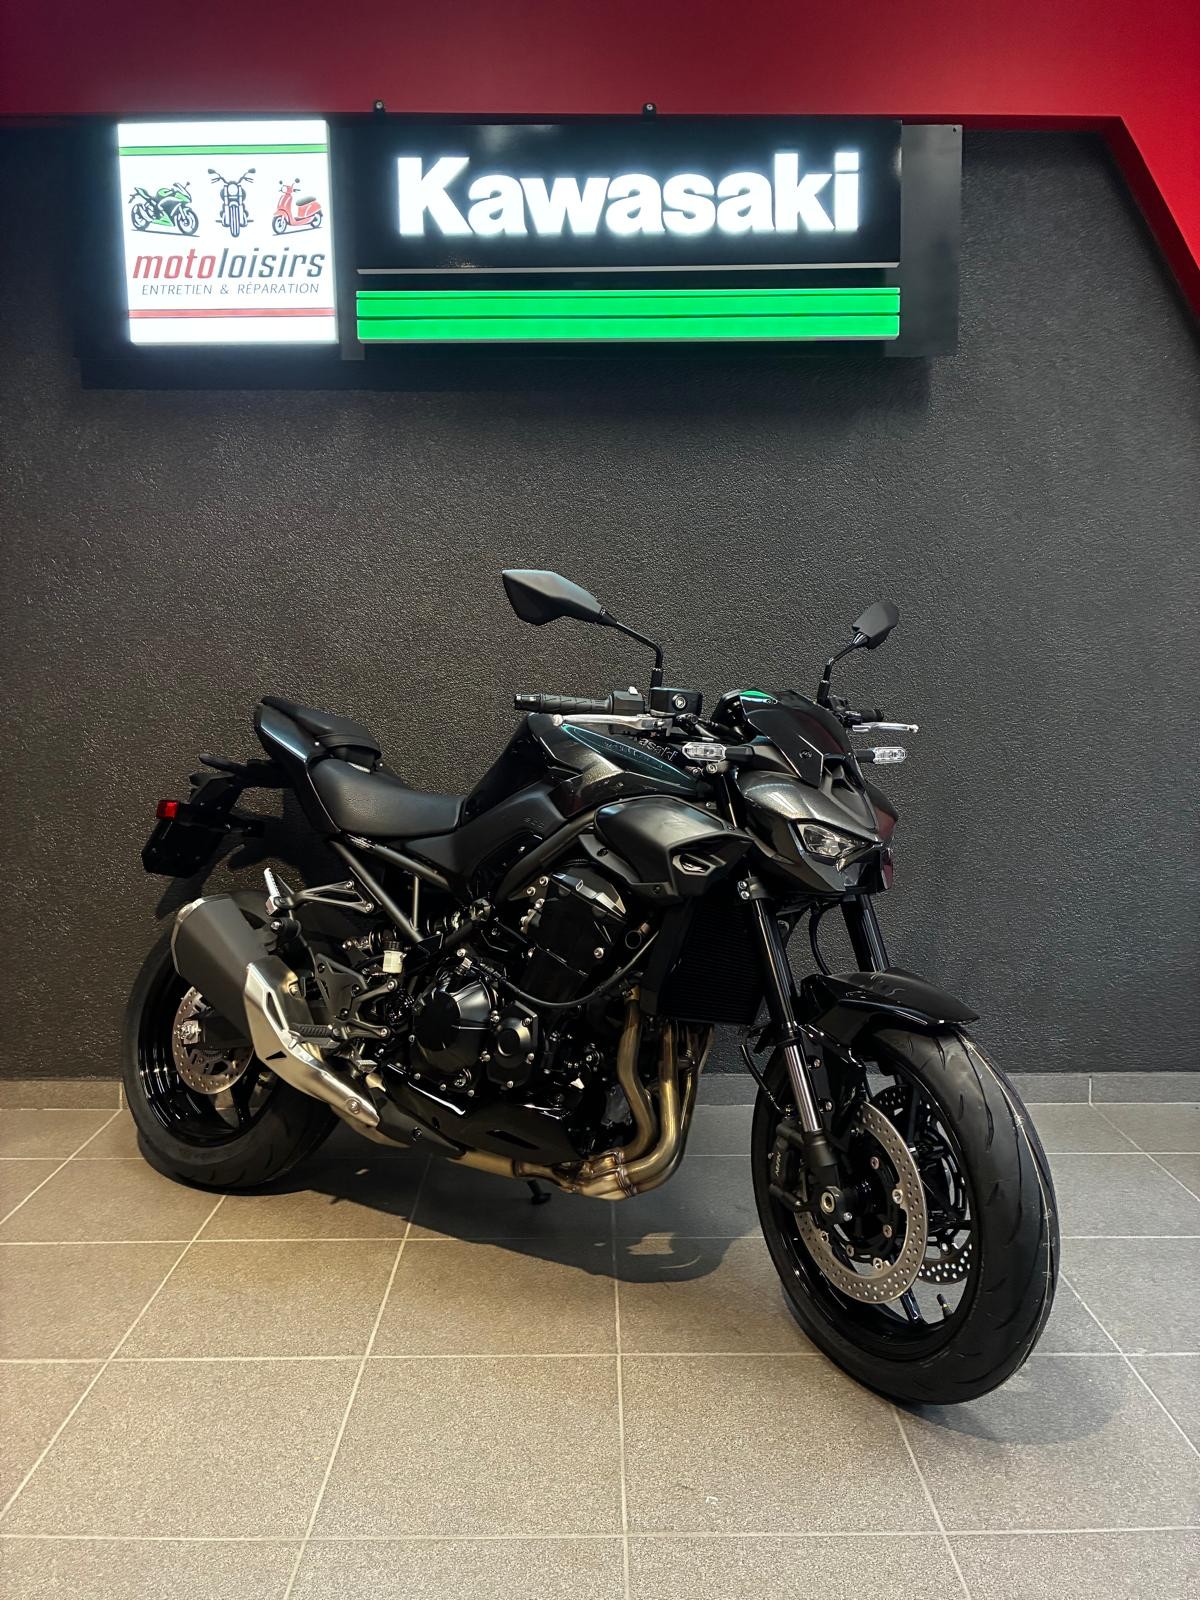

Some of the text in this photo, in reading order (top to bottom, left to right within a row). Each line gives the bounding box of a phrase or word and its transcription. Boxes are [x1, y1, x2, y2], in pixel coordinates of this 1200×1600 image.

[397, 151, 860, 236] Kawasaki
[132, 247, 326, 279] motoloisirs
[142, 281, 320, 296] ENTRETIEN & RÉPARATION
